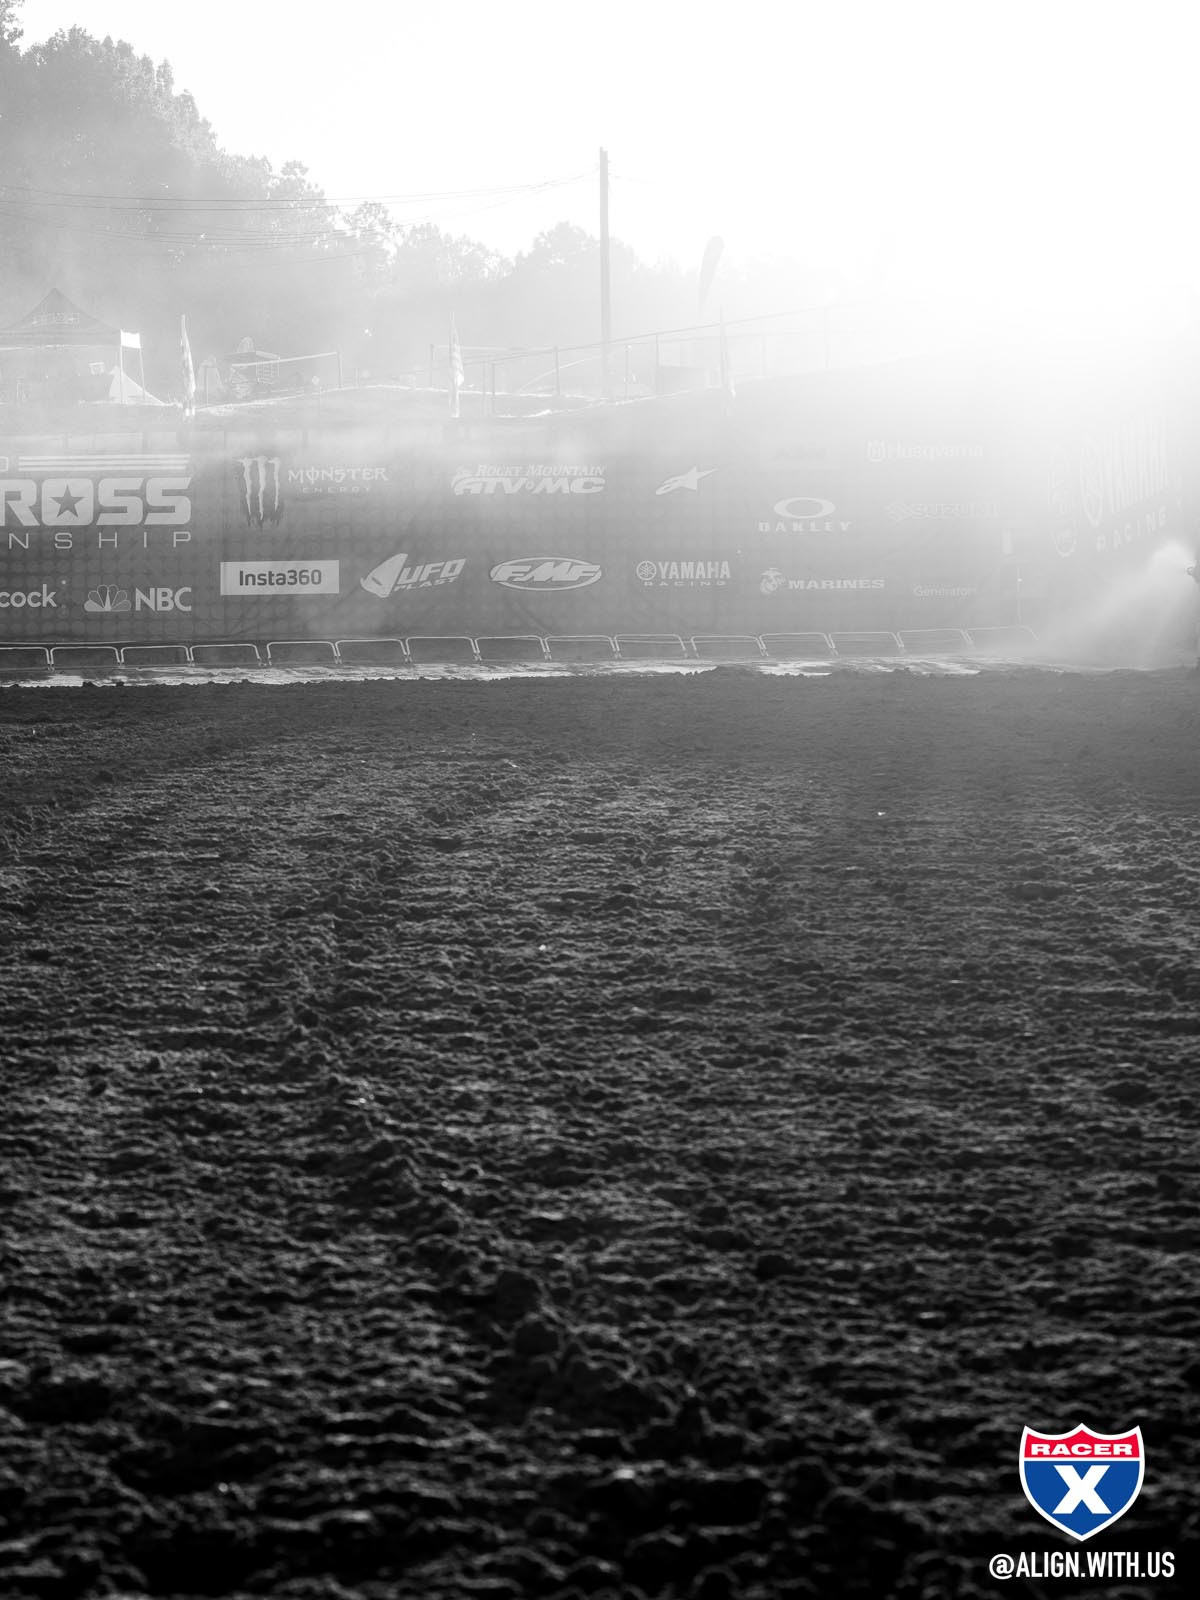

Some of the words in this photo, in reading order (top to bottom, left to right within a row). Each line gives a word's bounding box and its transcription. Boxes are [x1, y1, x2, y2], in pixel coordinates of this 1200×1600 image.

[287, 466, 390, 484] MONSTER
[476, 463, 524, 477] ROCKY
[527, 463, 608, 477] MOUNTAIN
[757, 519, 853, 532] OAKLEY
[239, 569, 323, 586] Insta360
[397, 558, 467, 585] UFO
[491, 561, 601, 582] FMF
[658, 560, 731, 579] YAMAHA
[394, 576, 460, 592] PLAST
[788, 578, 886, 590] MARINES
[135, 586, 193, 612] NBC
